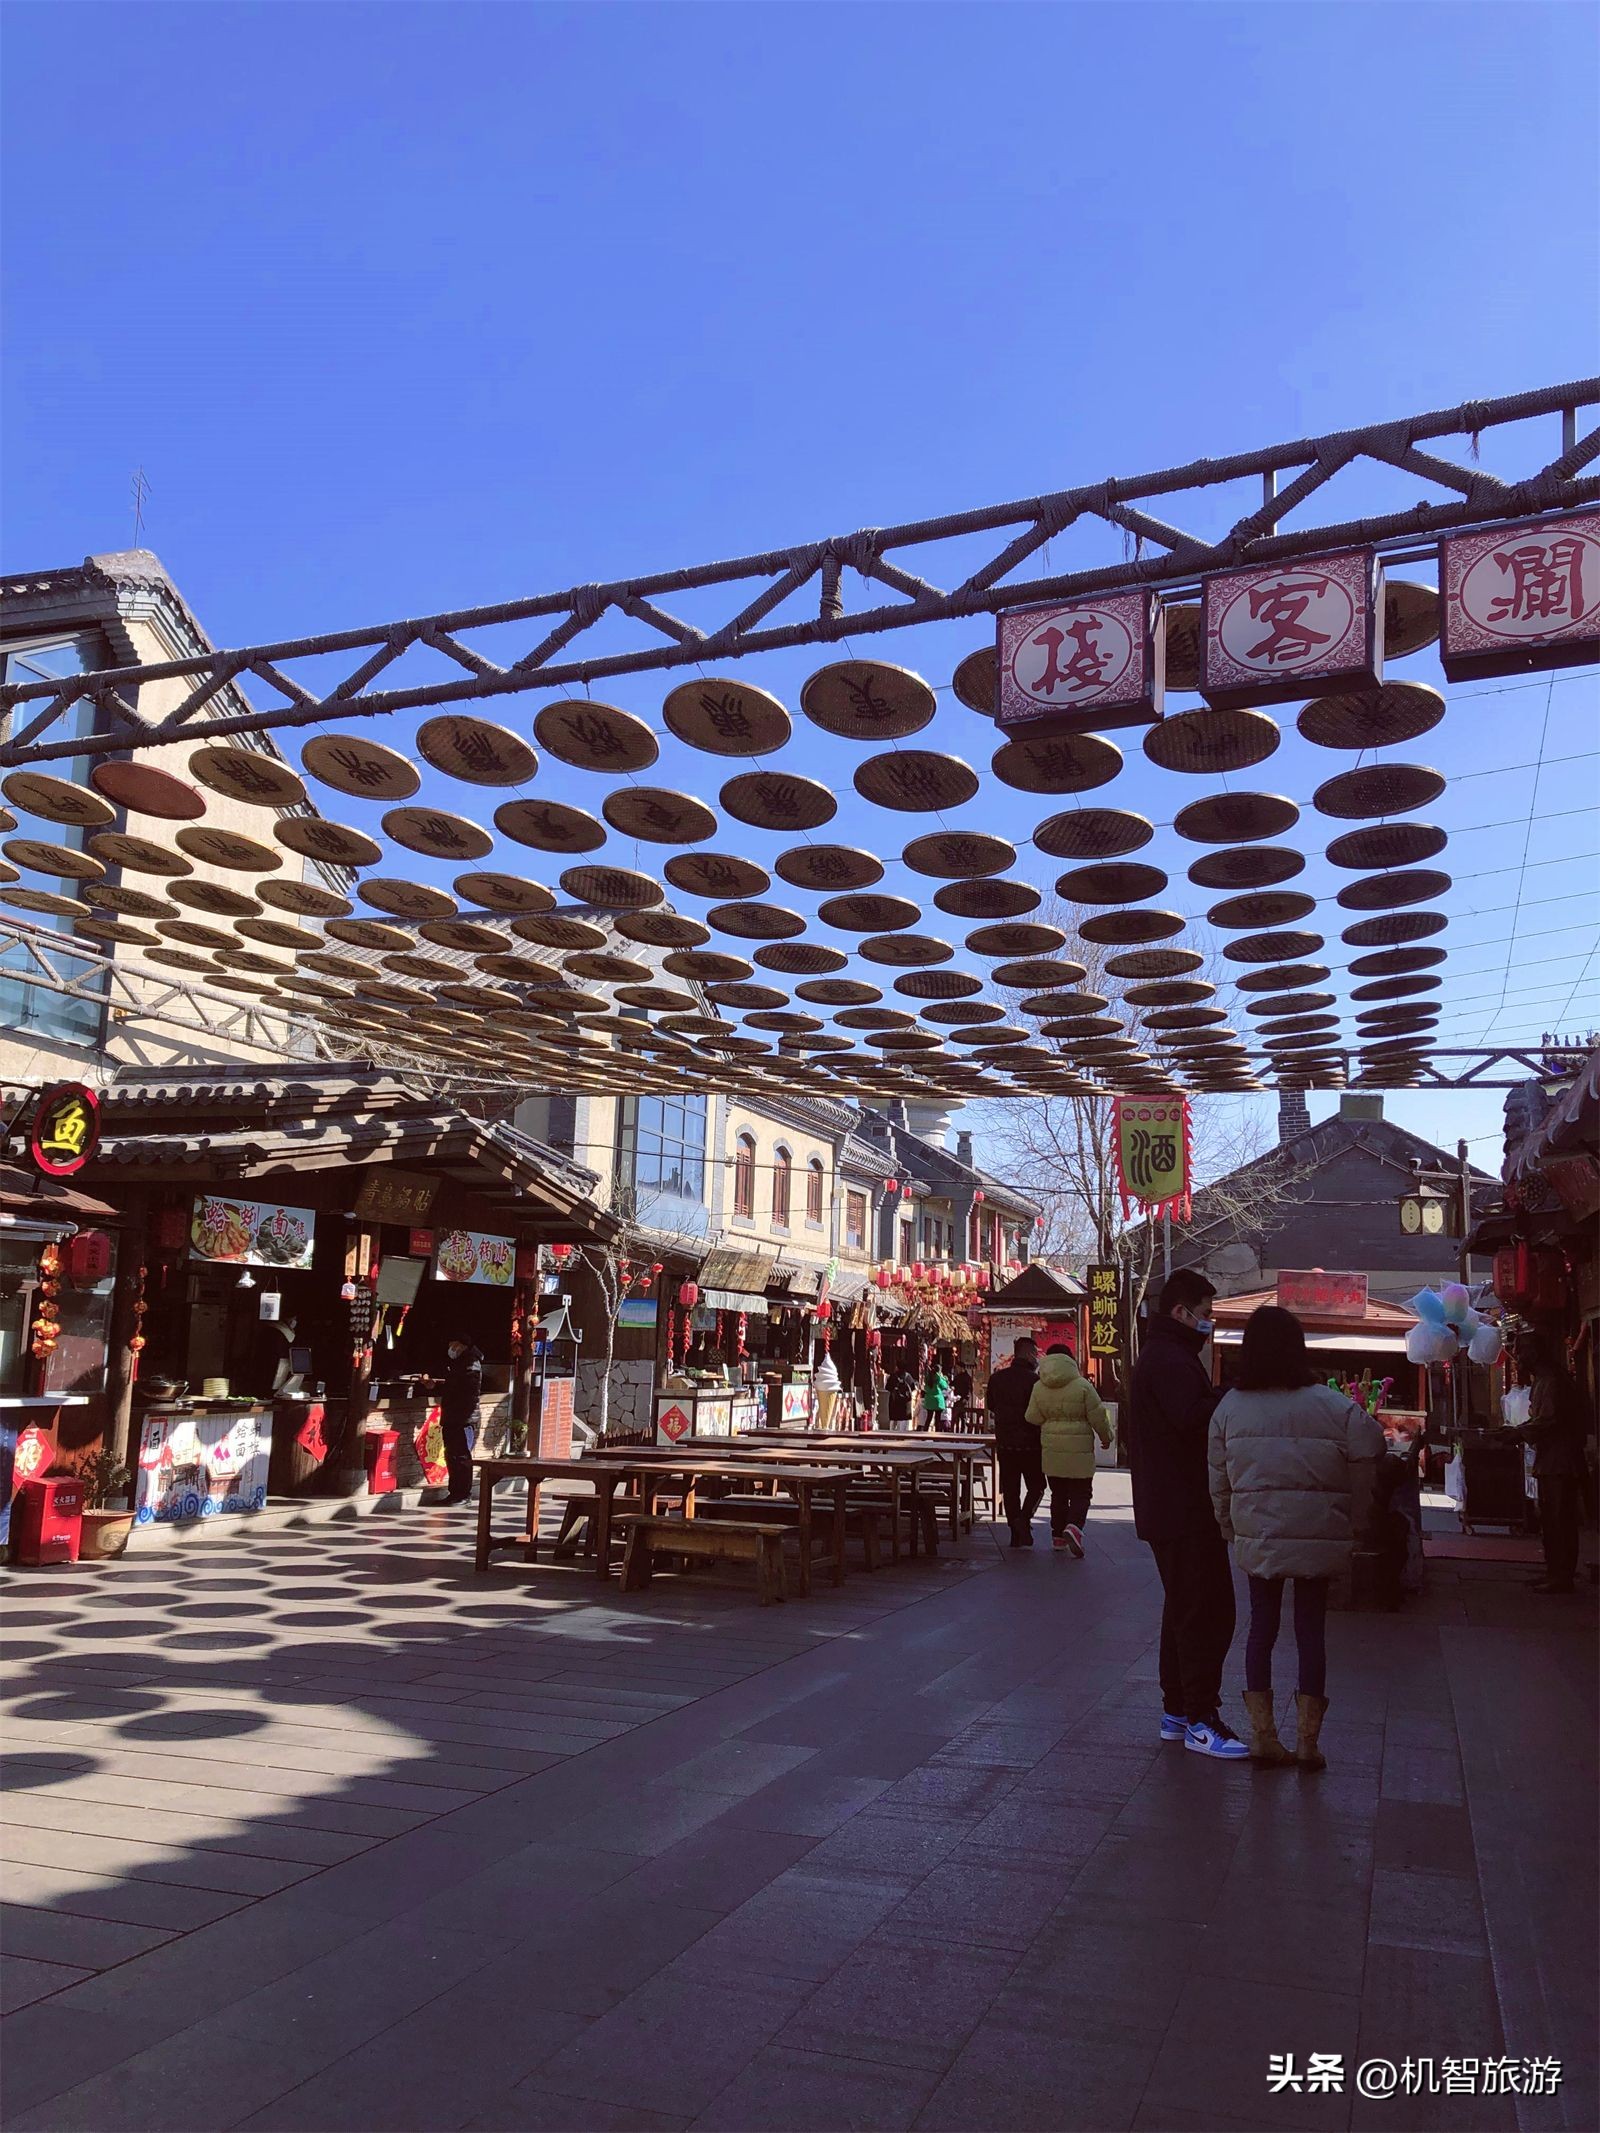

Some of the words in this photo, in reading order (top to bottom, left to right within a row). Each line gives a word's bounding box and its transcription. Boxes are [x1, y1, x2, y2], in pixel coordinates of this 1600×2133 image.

[1246, 580, 1331, 664] 客
[41, 1099, 86, 1155] 鱼
[1130, 1129, 1176, 1187] 酒
[1091, 1270, 1119, 1345] 螺蛳粉
[666, 1417, 682, 1436] 福
